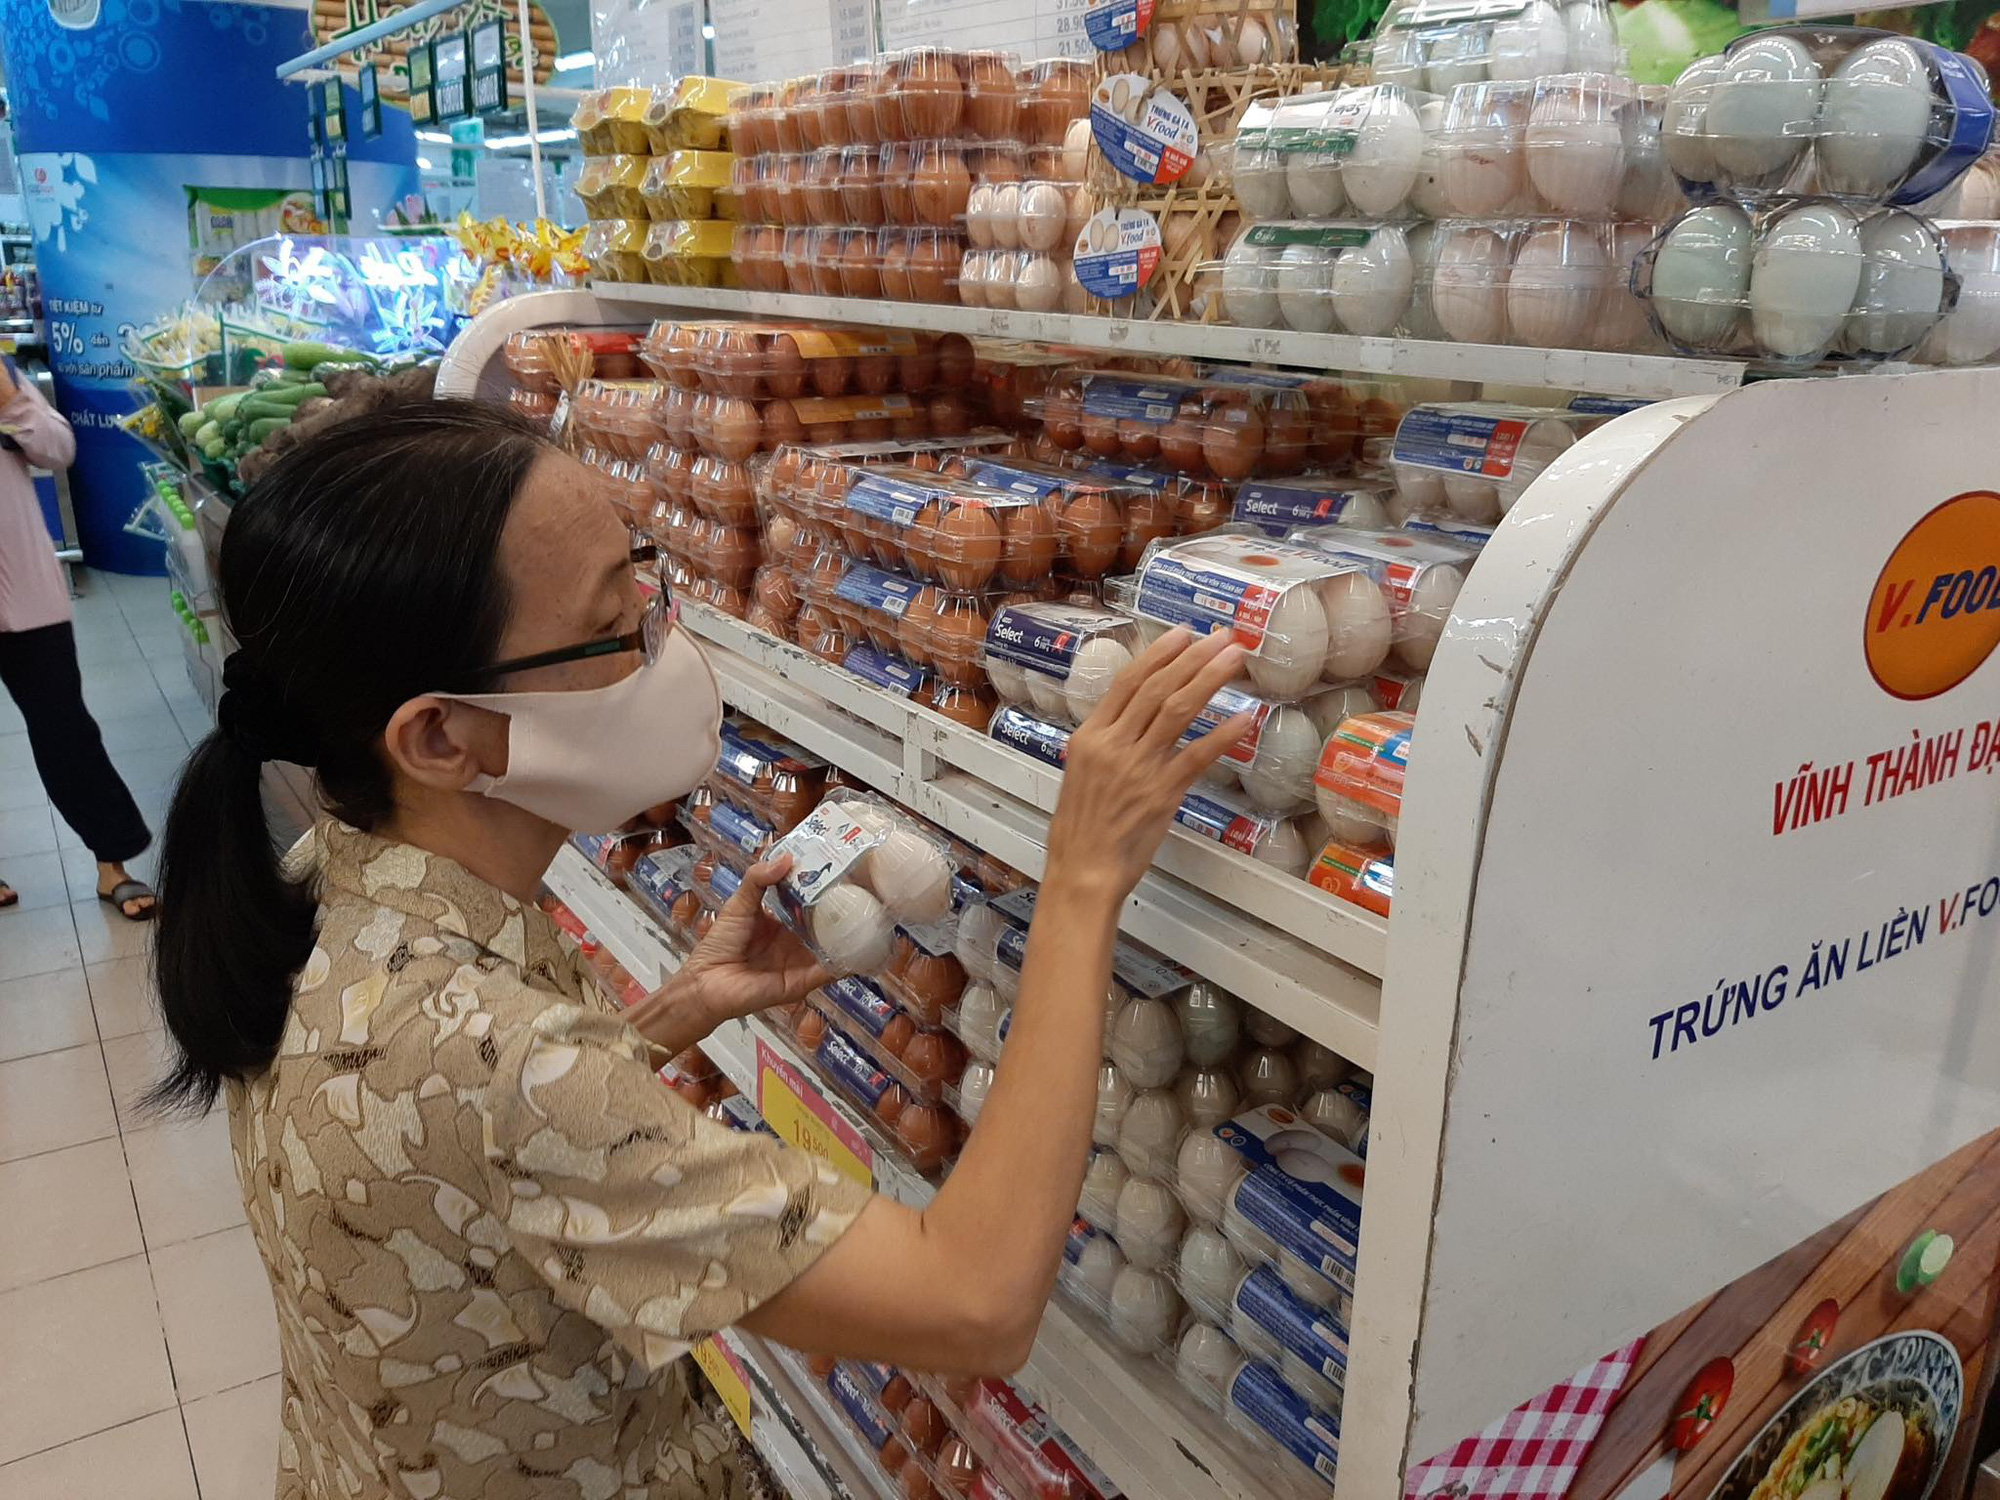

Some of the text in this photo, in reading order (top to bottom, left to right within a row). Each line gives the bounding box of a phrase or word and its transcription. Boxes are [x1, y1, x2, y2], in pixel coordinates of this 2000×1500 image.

[51, 320, 84, 355] 5%
[1245, 498, 1278, 516] Select
[1291, 504, 1300, 517] 6
[995, 624, 1024, 644] Select
[1034, 635, 1041, 648] 6
[1002, 721, 1031, 745] Select
[1772, 761, 1854, 835] VĨNH
[1863, 729, 1963, 807] THÀNH
[1648, 876, 2000, 1060] TRỨNG ĂN LIỀN V.FO
[827, 1040, 851, 1065] Select
[760, 1046, 804, 1099] Khuyến mãi
[837, 1372, 860, 1401] Select
[988, 1397, 1017, 1432] Select
